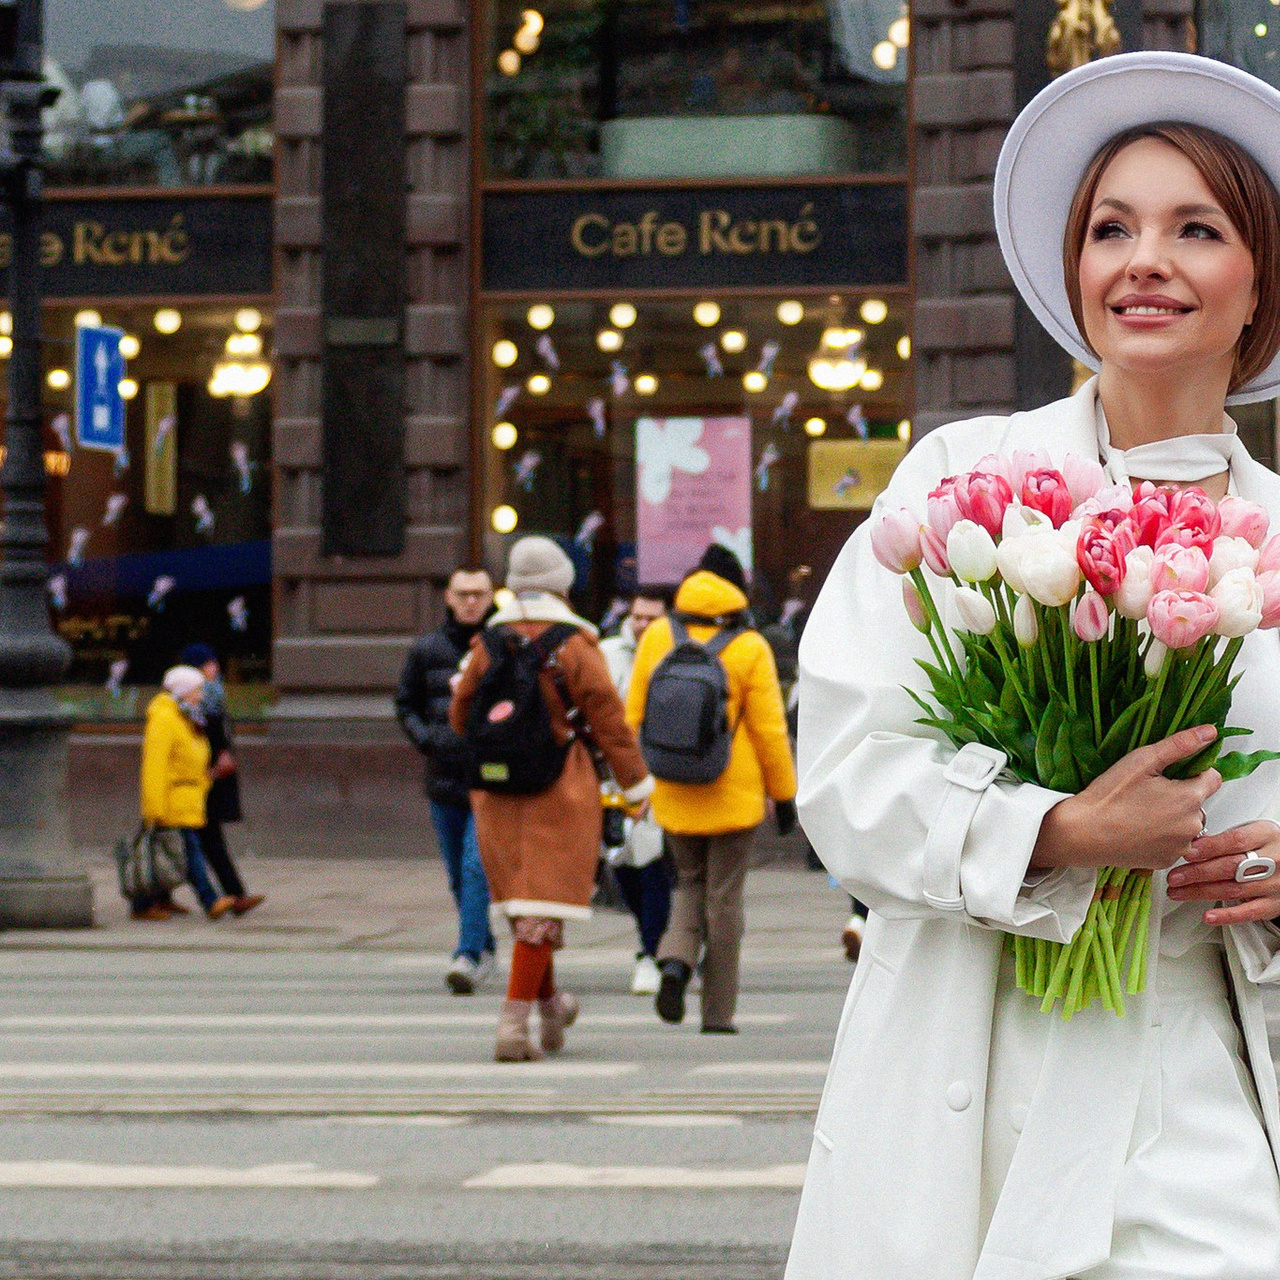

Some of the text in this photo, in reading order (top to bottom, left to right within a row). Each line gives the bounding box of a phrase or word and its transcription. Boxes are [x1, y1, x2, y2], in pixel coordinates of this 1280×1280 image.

[73, 212, 188, 266] René
[570, 204, 821, 257] Cafe René
